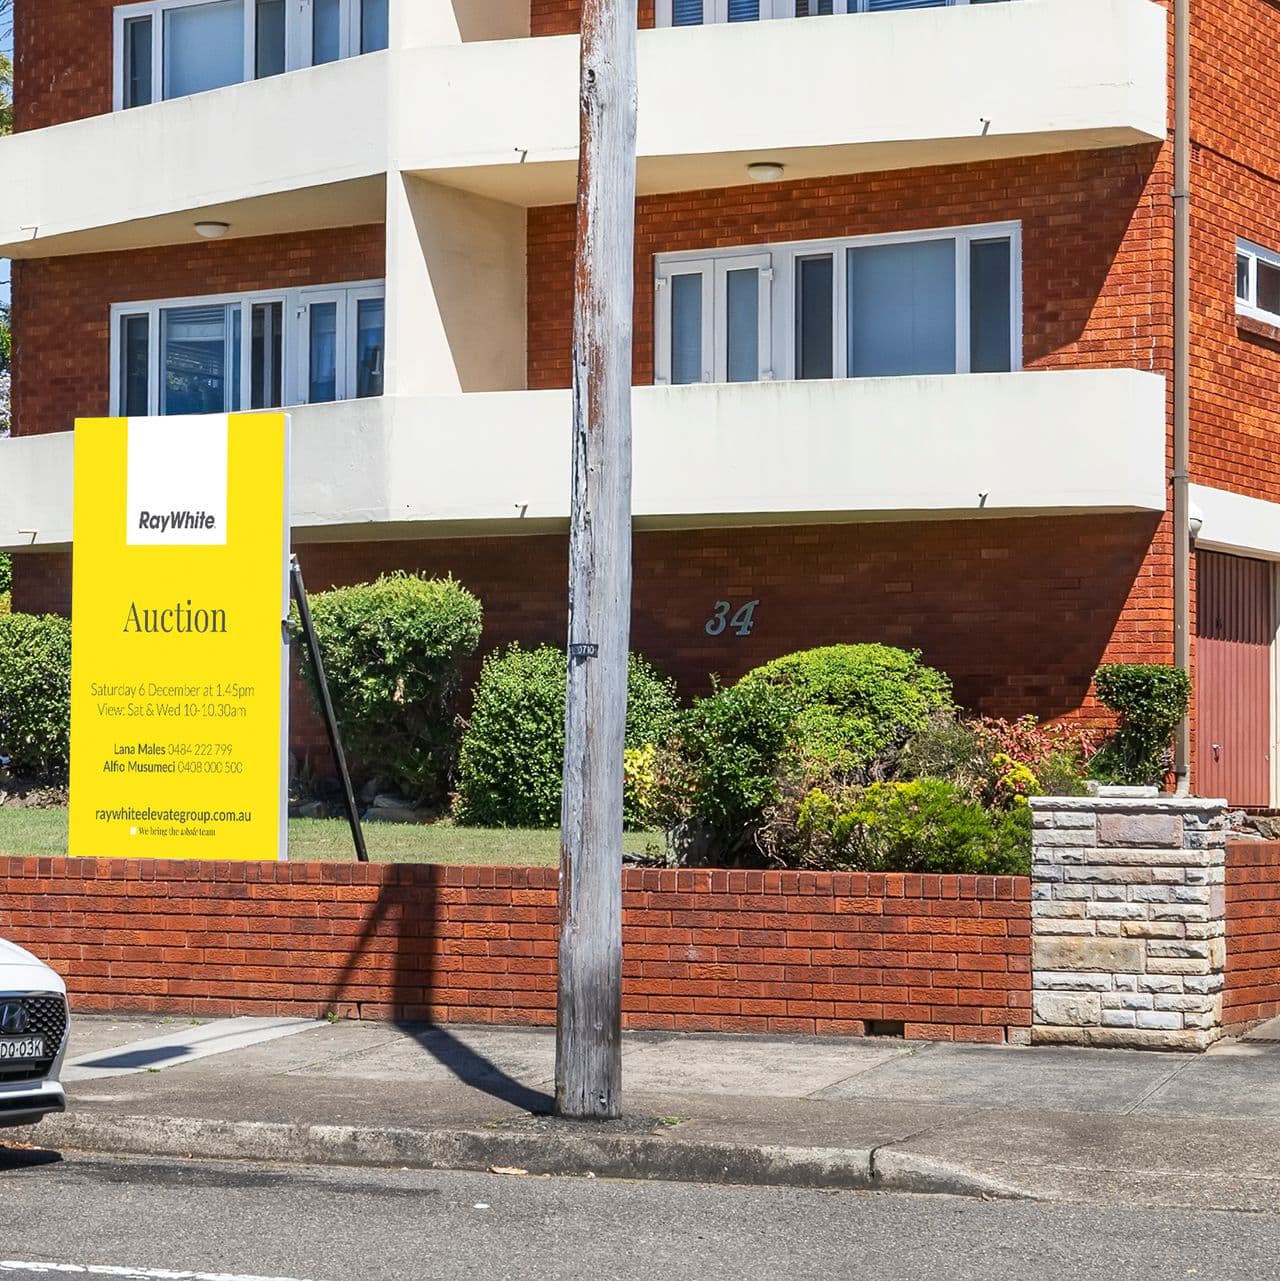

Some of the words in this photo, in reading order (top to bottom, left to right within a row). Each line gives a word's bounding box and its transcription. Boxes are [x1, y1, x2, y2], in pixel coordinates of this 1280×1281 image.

[123, 599, 228, 633] Auction
[705, 599, 760, 636] 34
[90, 682, 136, 699] Saturday
[138, 683, 146, 697] 6
[148, 683, 200, 697] December
[203, 685, 213, 697] at
[216, 684, 255, 699] 1.45pm
[97, 703, 125, 717] View:
[127, 703, 144, 717] Sat
[146, 703, 155, 717] &
[155, 703, 181, 717] Wed
[184, 703, 247, 718] 10-10.30am
[114, 743, 135, 755] Lana
[138, 743, 166, 755] Males
[194, 744, 213, 756] 222
[214, 744, 233, 756] 799
[103, 761, 125, 773] Alfio
[127, 761, 176, 773] Musumeci
[95, 807, 252, 824] raywhiteelevategroup.com.au
[138, 826, 149, 836] We
[150, 826, 168, 838] bring
[169, 826, 179, 836] the
[199, 827, 216, 837] team
